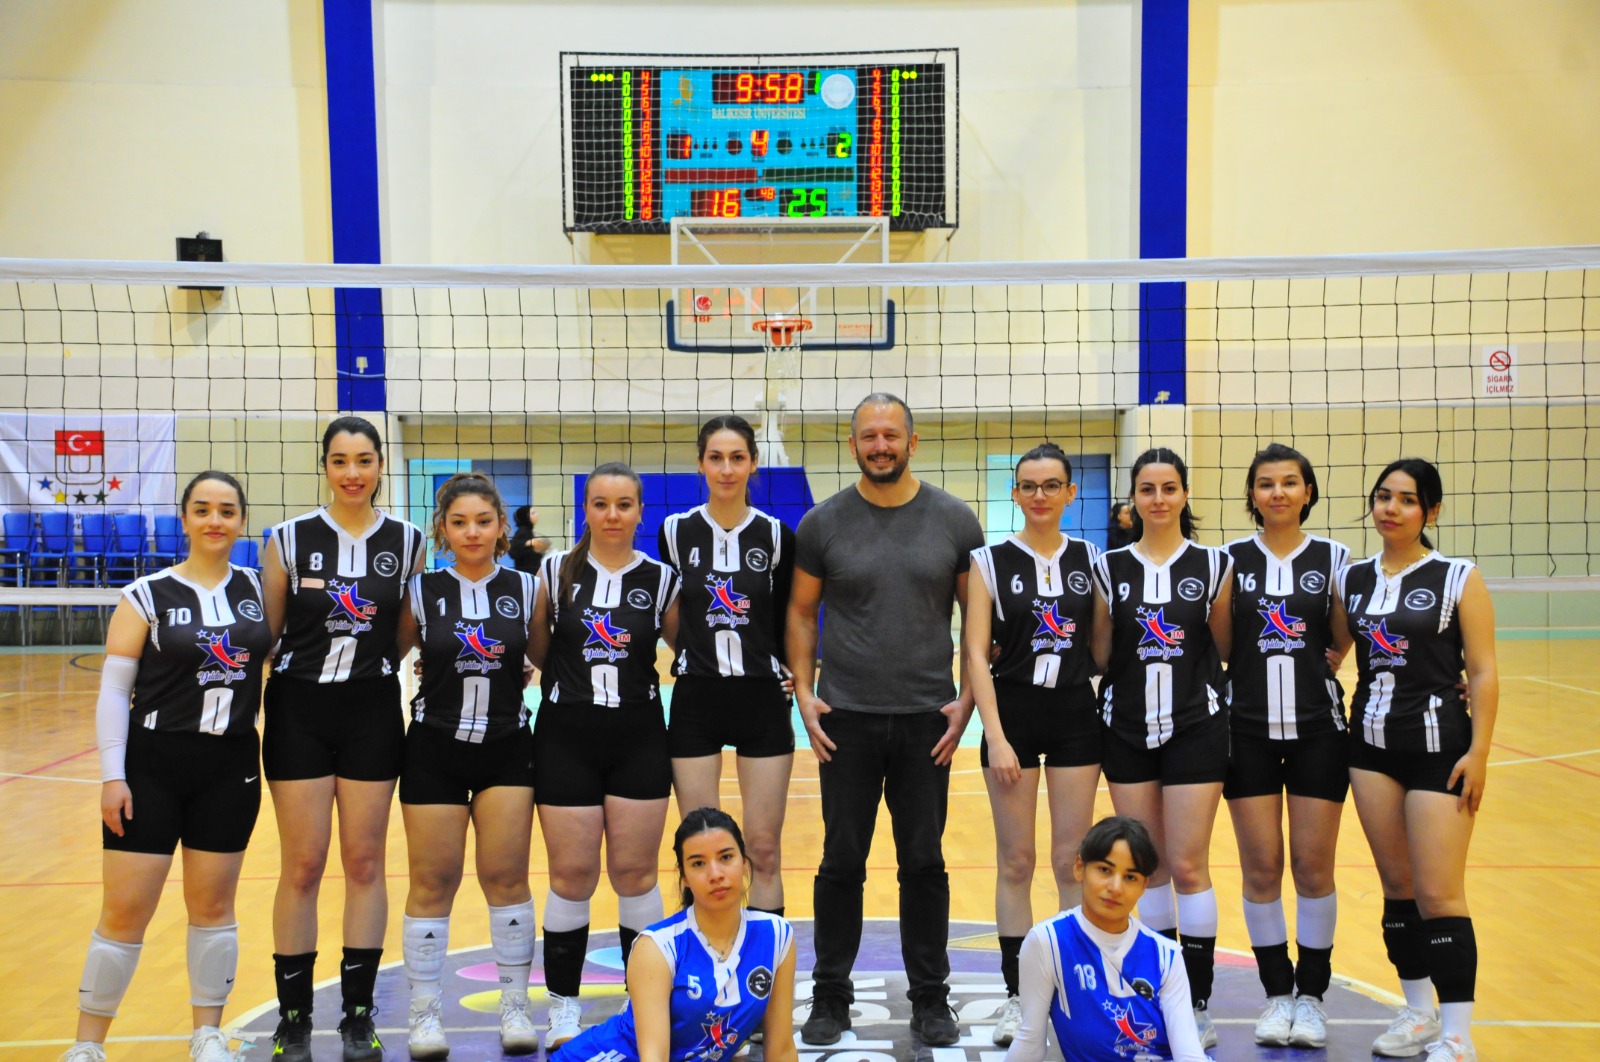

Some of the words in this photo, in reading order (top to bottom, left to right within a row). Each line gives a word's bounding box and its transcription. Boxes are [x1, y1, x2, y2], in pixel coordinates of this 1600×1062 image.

[736, 73, 802, 103] 9:58
[684, 135, 691, 158] 1
[751, 130, 769, 156] 4
[836, 132, 852, 158] 2
[712, 188, 739, 217] 16
[760, 187, 775, 201] 48
[788, 188, 826, 218] 25
[1487, 374, 1512, 383] SİGARA
[1486, 384, 1514, 394] İÇİLMEZ
[309, 552, 323, 571] 8
[688, 547, 700, 567] 4
[1010, 574, 1024, 595] 6
[1118, 582, 1130, 602] 9
[1237, 573, 1257, 593] 16
[572, 583, 581, 602] 7
[362, 606, 377, 614] 3M
[436, 598, 446, 616] 1
[738, 600, 750, 608] 3M
[166, 608, 192, 626] 10
[1062, 623, 1076, 632] 3M
[1171, 630, 1184, 639] 3M
[1292, 622, 1306, 631] 3M
[617, 634, 630, 642] 3M
[235, 653, 250, 662] 3M
[491, 645, 505, 654] 3M
[1074, 964, 1096, 991] 18
[687, 975, 702, 1000] 5
[1144, 1029, 1157, 1040] 3M
